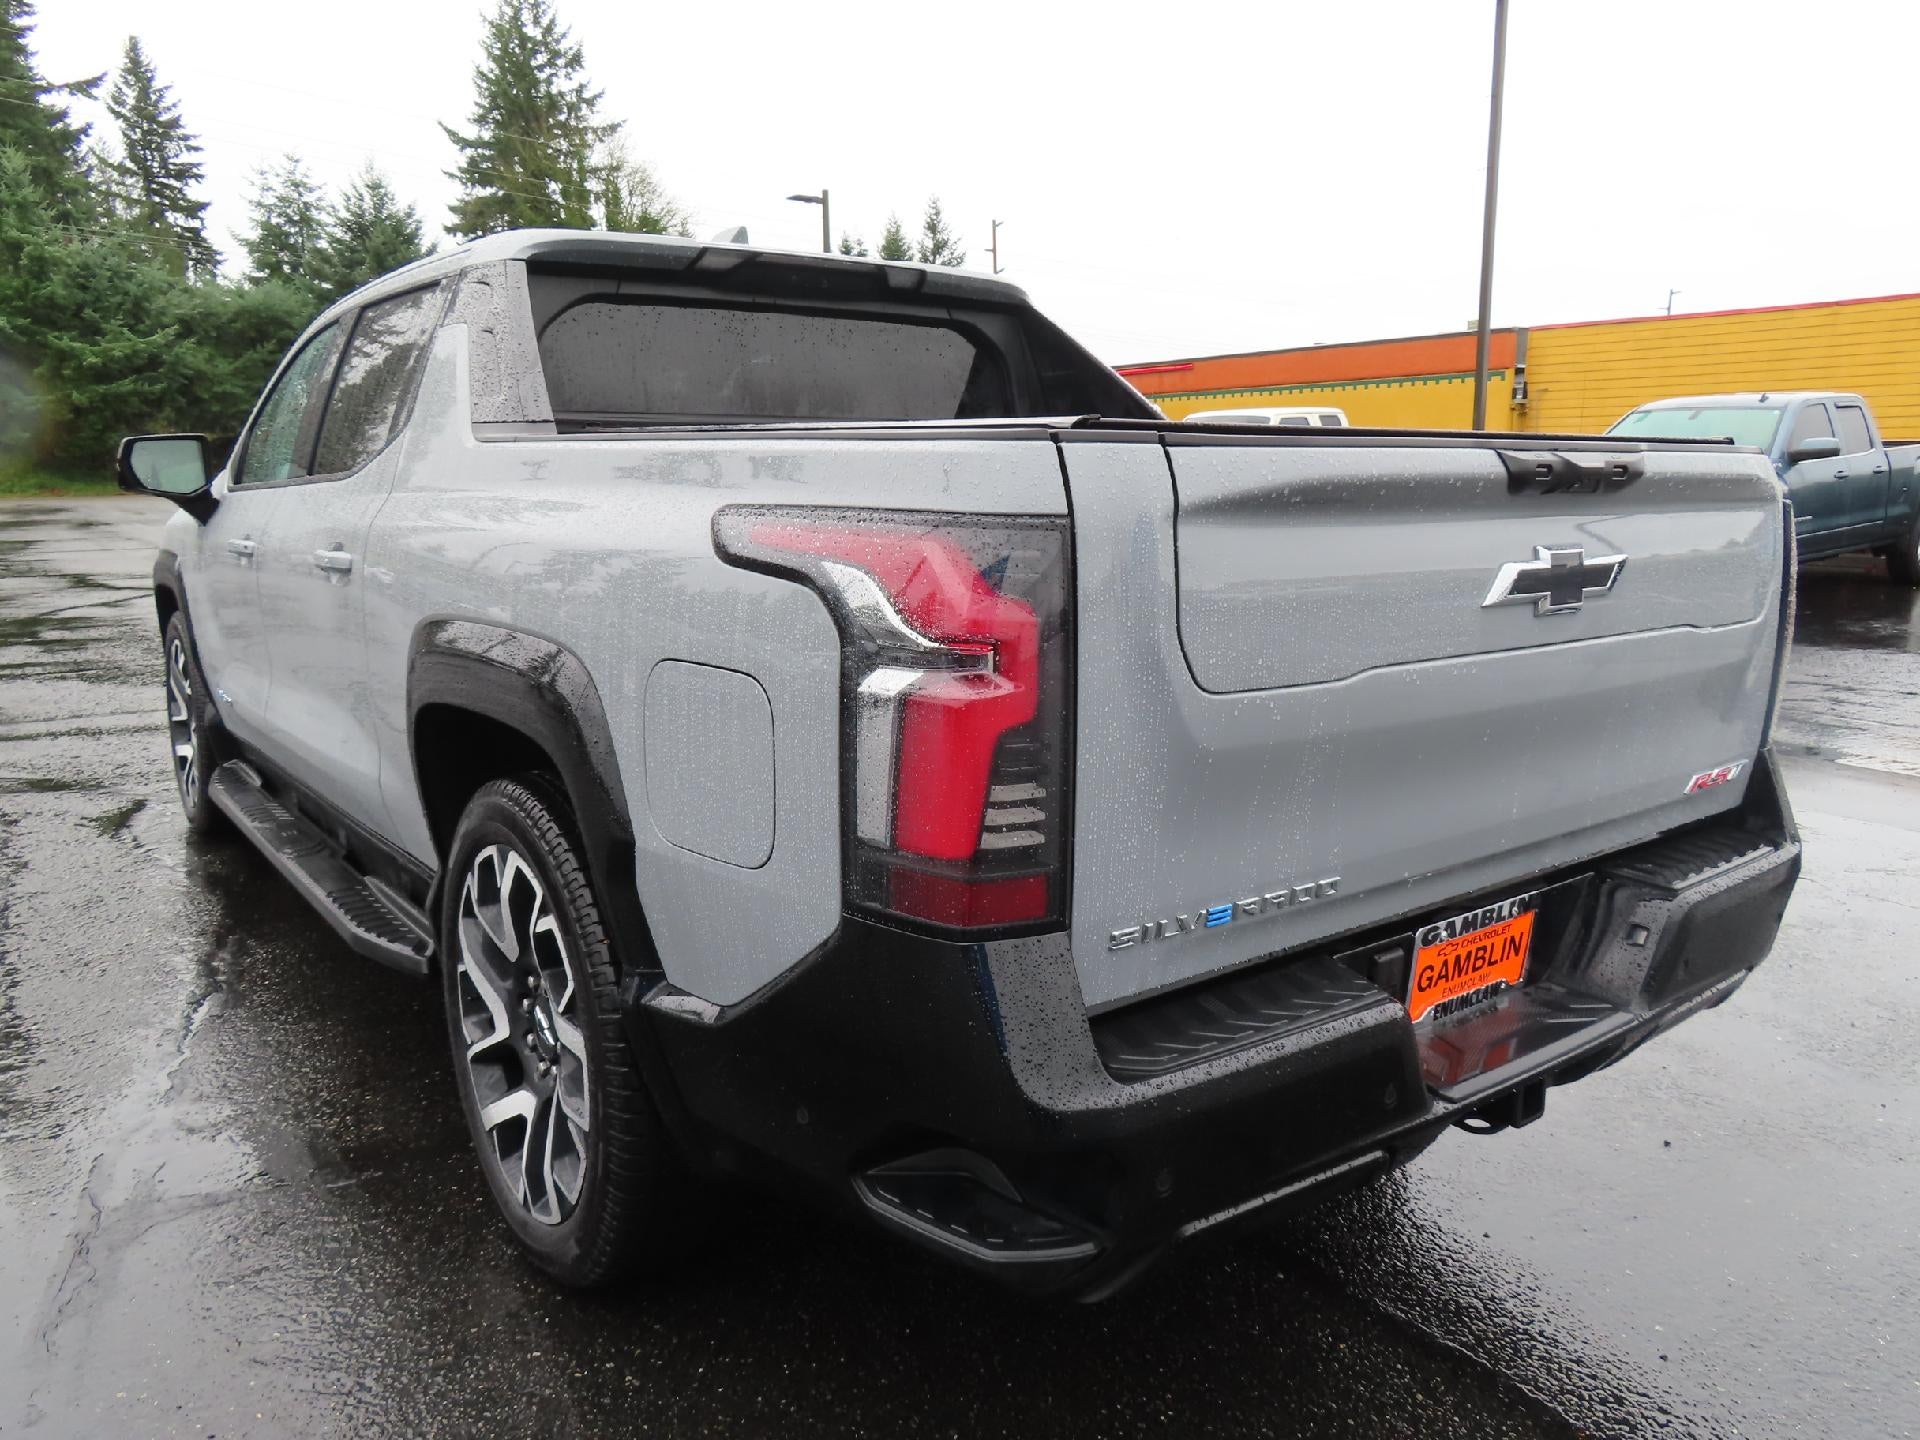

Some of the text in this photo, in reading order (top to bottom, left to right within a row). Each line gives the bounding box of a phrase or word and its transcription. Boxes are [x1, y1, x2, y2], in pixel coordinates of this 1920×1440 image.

[1108, 876, 1341, 951] SILVERADO
[1461, 924, 1512, 948] CHEVROLET
[1417, 932, 1525, 993] GAMBLIN
[1442, 972, 1491, 998] ENUMCLAW
